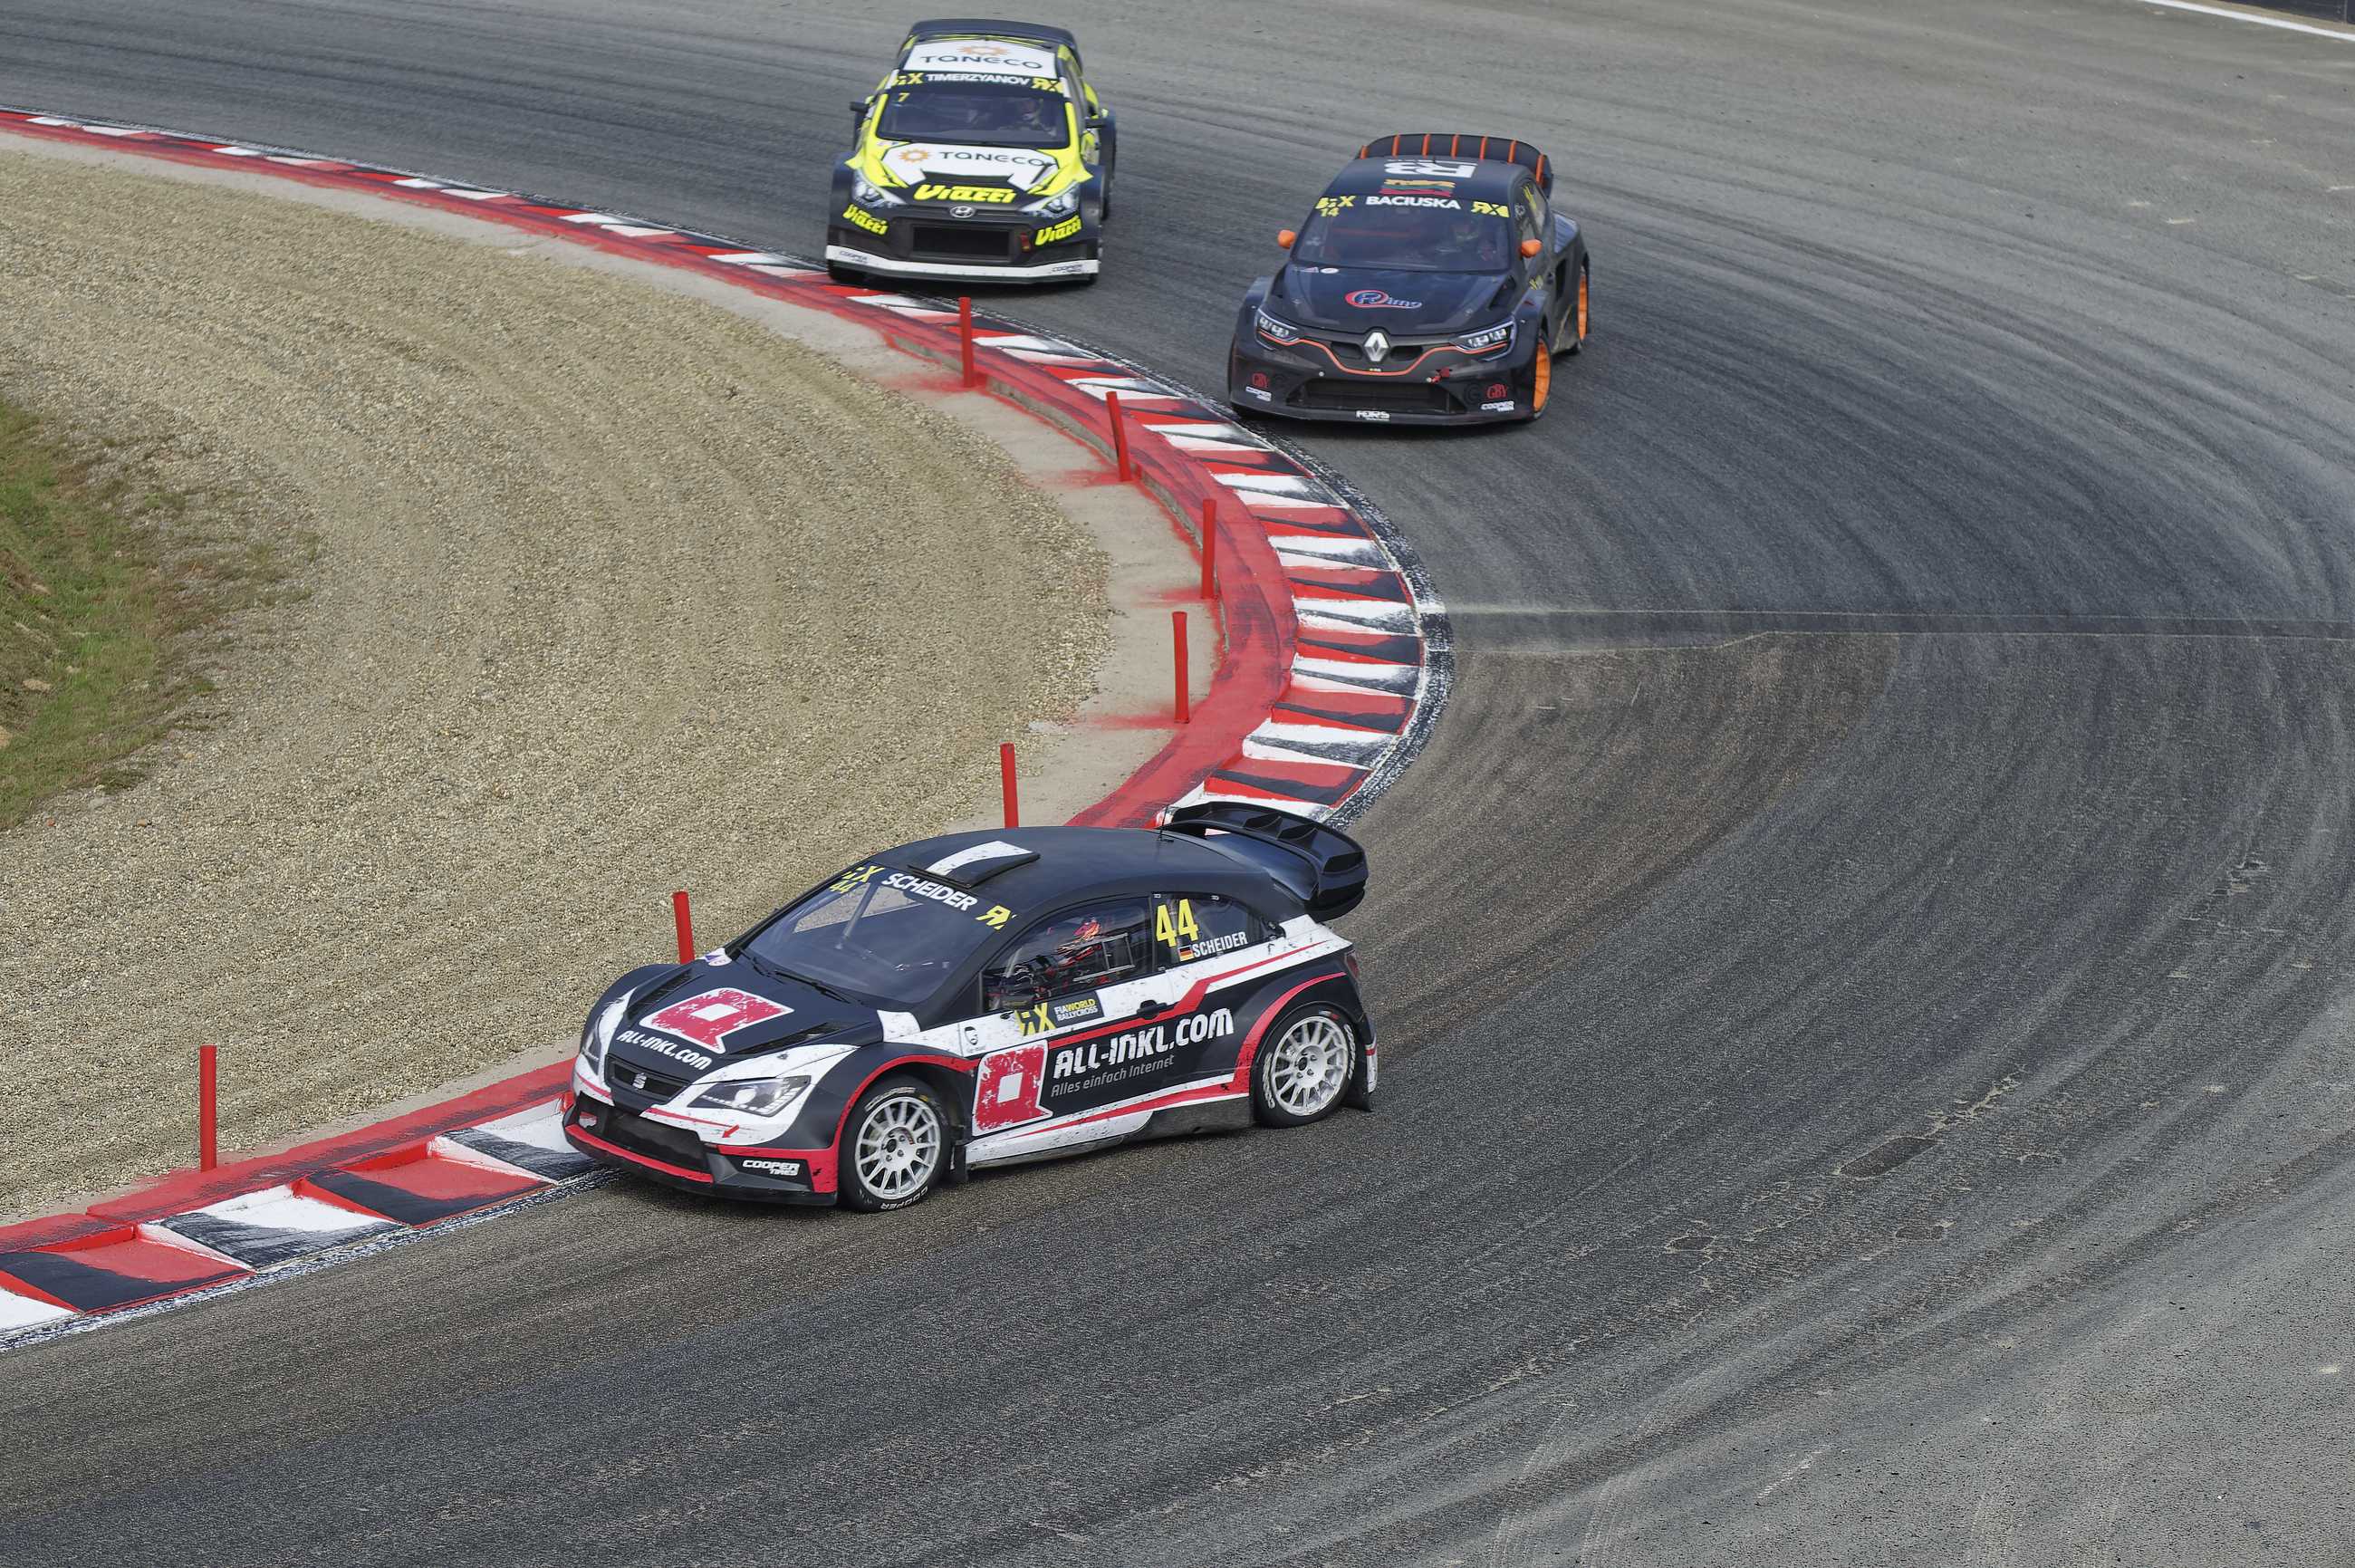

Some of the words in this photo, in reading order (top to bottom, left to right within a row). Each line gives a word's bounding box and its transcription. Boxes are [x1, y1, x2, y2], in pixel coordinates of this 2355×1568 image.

[927, 72, 1031, 86] TIMERZYANOV
[898, 92, 910, 102] 7
[1365, 196, 1461, 210] BACIUSKA
[1320, 207, 1341, 217] 14
[829, 880, 859, 894] 44
[881, 872, 978, 911] SCHEIDER
[1156, 899, 1198, 948] 44
[1192, 931, 1248, 958] SCHEIDER
[1056, 1005, 1099, 1022] RALLYCROSS
[1051, 1081, 1081, 1098] Alles
[1083, 1067, 1127, 1090] einfach
[1129, 1054, 1175, 1079] Internet
[743, 1159, 801, 1172] COOPER
[880, 1185, 928, 1210] COOPER
